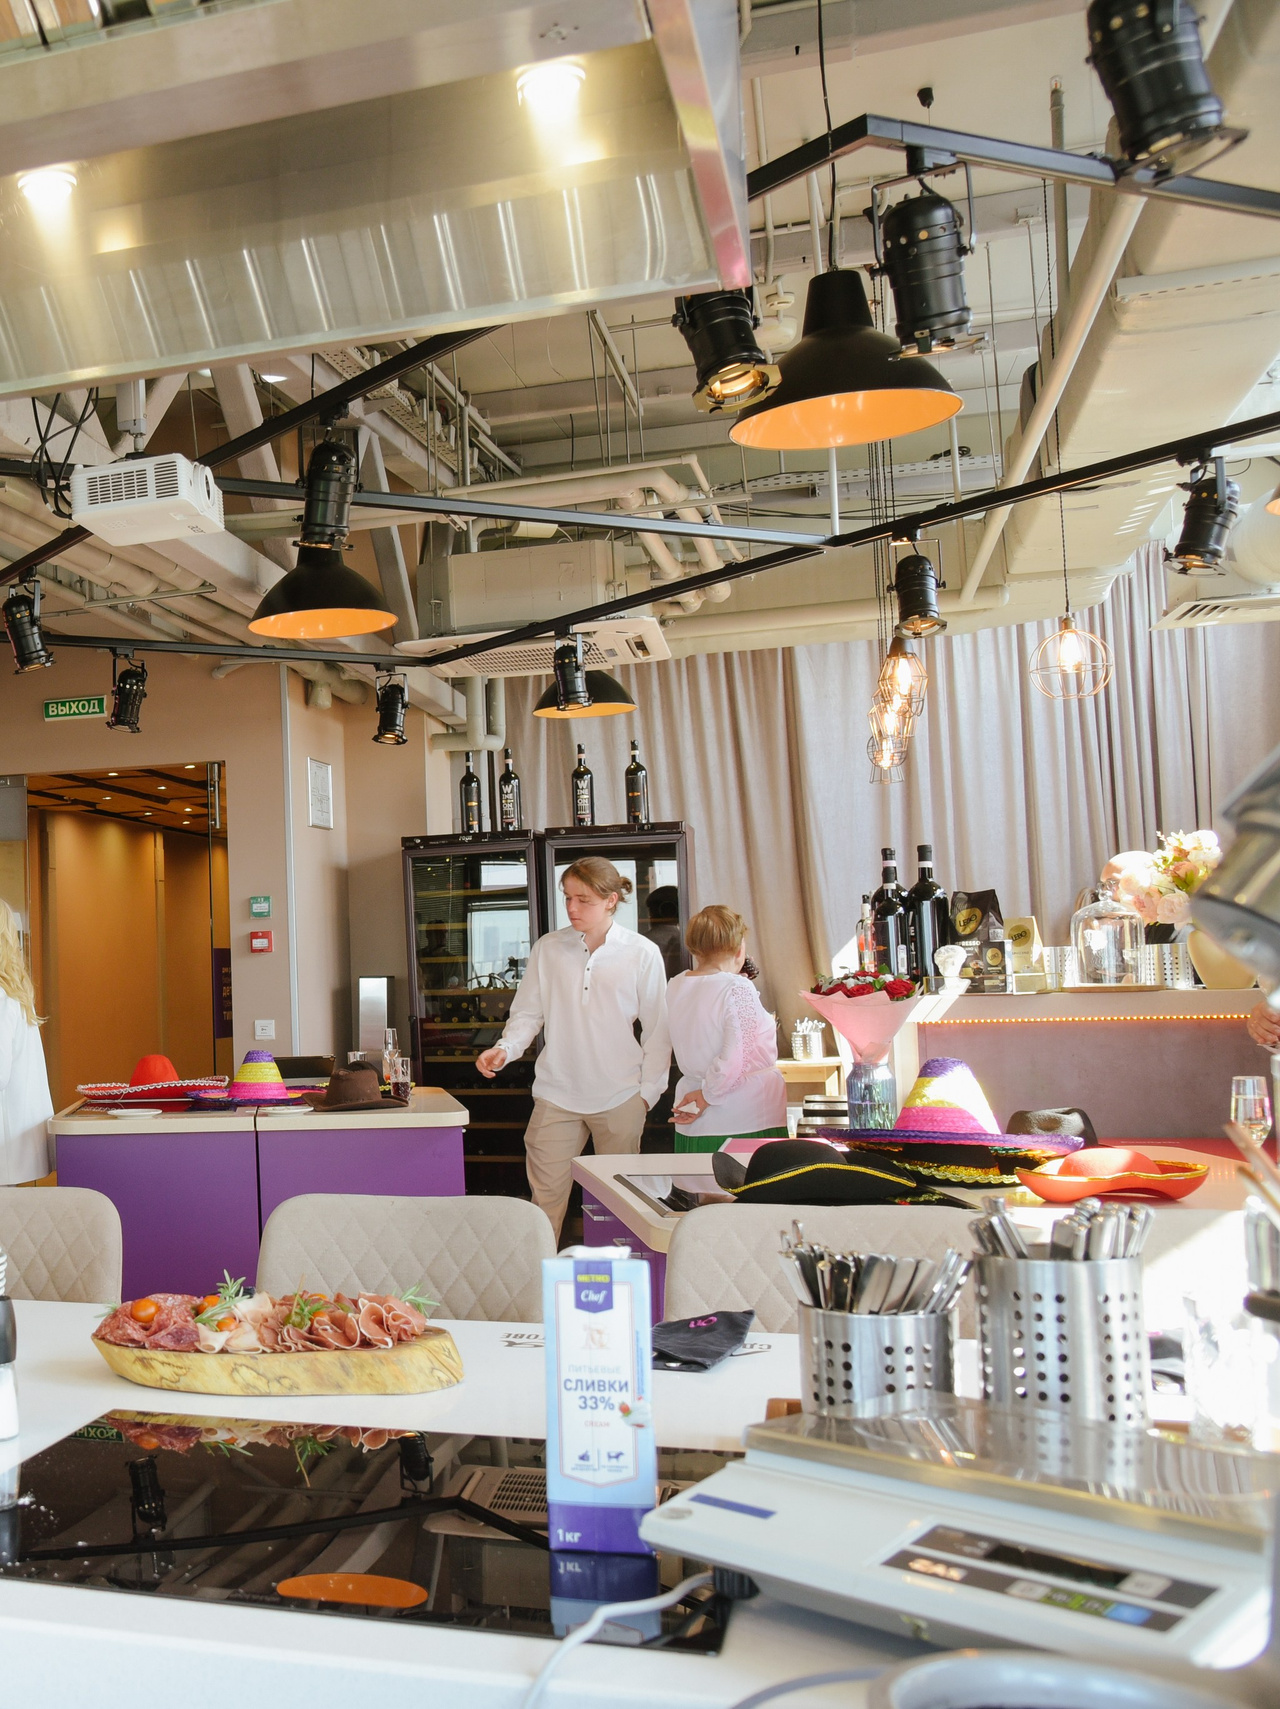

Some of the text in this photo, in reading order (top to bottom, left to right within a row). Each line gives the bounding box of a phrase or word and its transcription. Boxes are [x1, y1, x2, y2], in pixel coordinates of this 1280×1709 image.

[48, 700, 99, 716] ВЫХОД
[959, 914, 978, 928] LEBO
[1011, 930, 1027, 942] LEBO
[580, 1289, 608, 1305] Chef
[563, 1378, 629, 1393] СЛИВКИ
[578, 1395, 616, 1411] 33%
[556, 1528, 565, 1542] 1
